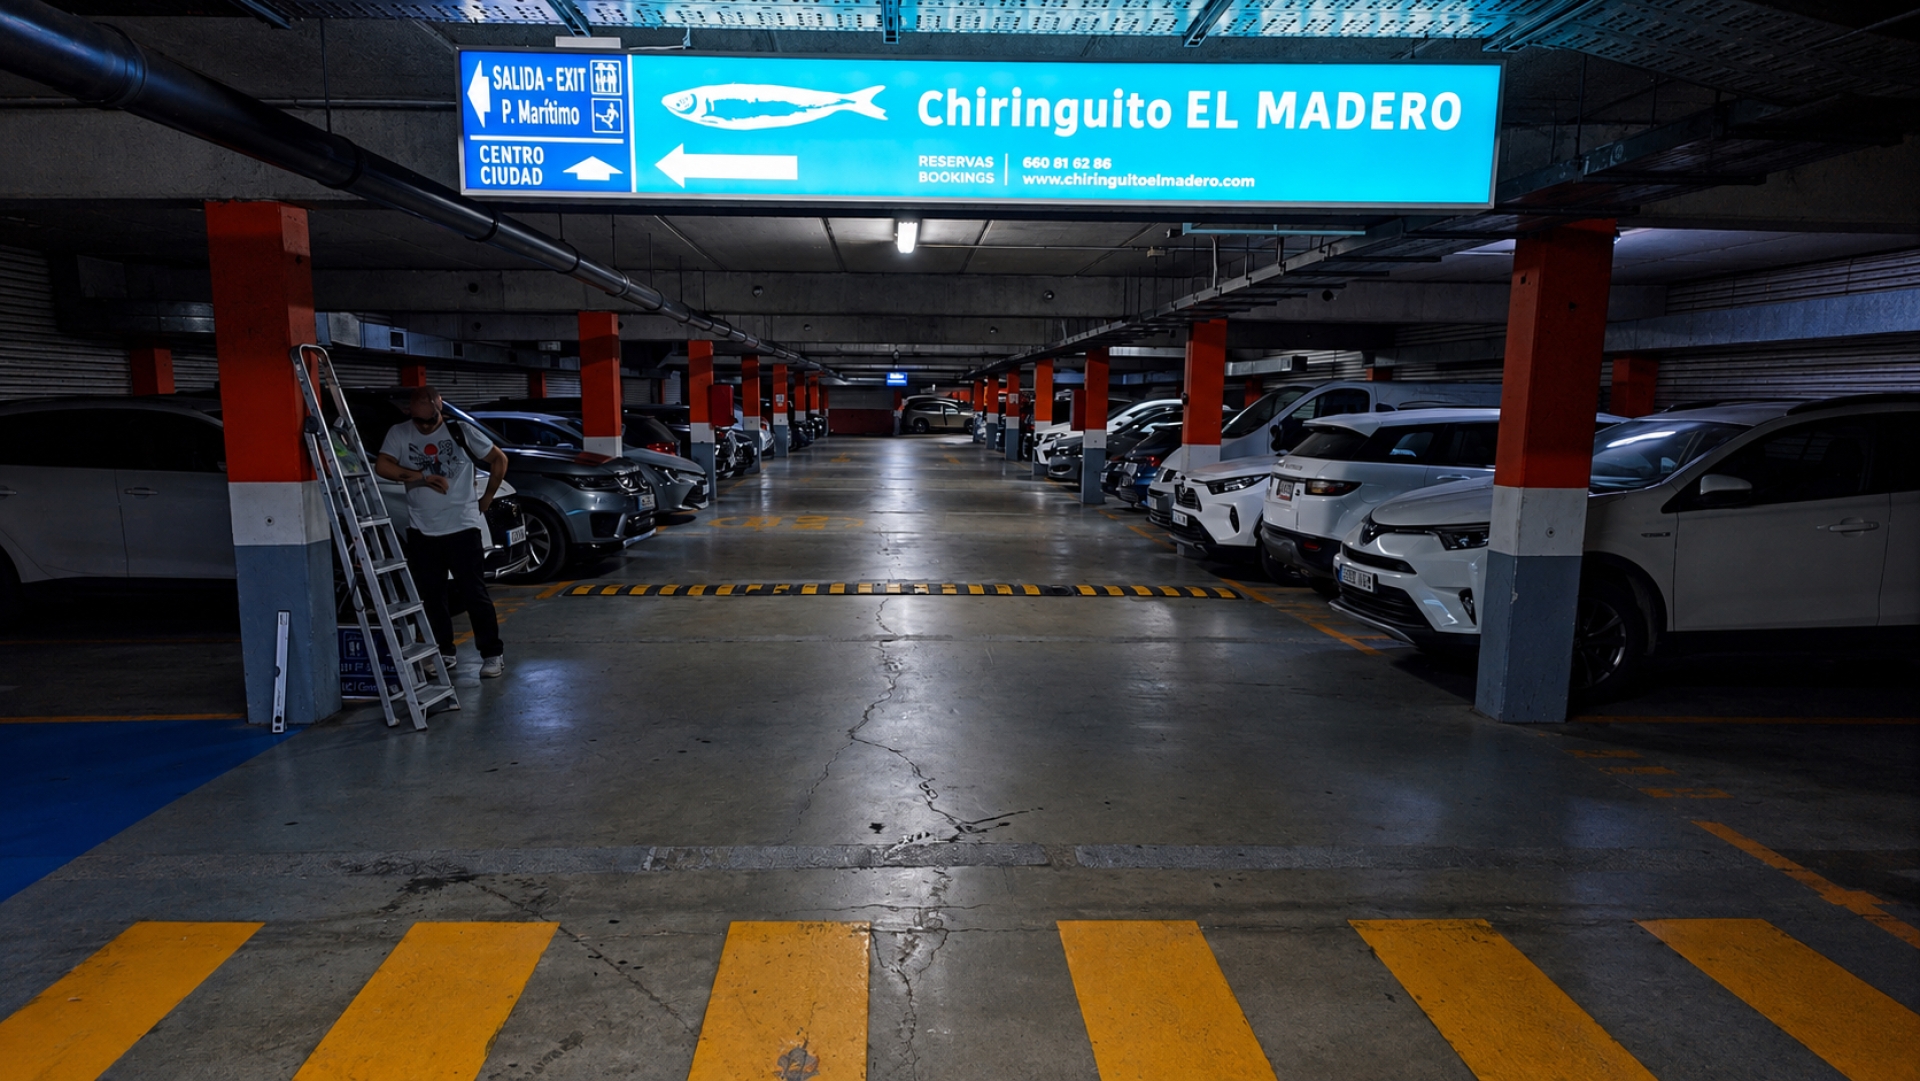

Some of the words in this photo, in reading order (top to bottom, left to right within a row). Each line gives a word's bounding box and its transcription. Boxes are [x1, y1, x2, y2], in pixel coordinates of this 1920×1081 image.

[492, 65, 545, 91] SALIDA
[556, 67, 586, 92] EXIT
[502, 98, 515, 124] P.
[518, 98, 580, 125] Marítimo
[917, 86, 1172, 137] Chiringuito
[1186, 90, 1239, 129] EL
[1256, 91, 1462, 131] MADERO
[479, 144, 544, 165] CENTRO
[918, 154, 995, 169] RESERVAS
[1022, 156, 1051, 169] 660
[1053, 157, 1069, 169] 81
[1072, 157, 1091, 170] 62
[1093, 157, 1112, 170] 86
[480, 165, 543, 186] CIUDAD
[918, 170, 996, 185] BOOKINGS
[1022, 172, 1256, 190] www.chiringuitoelmadero.com
